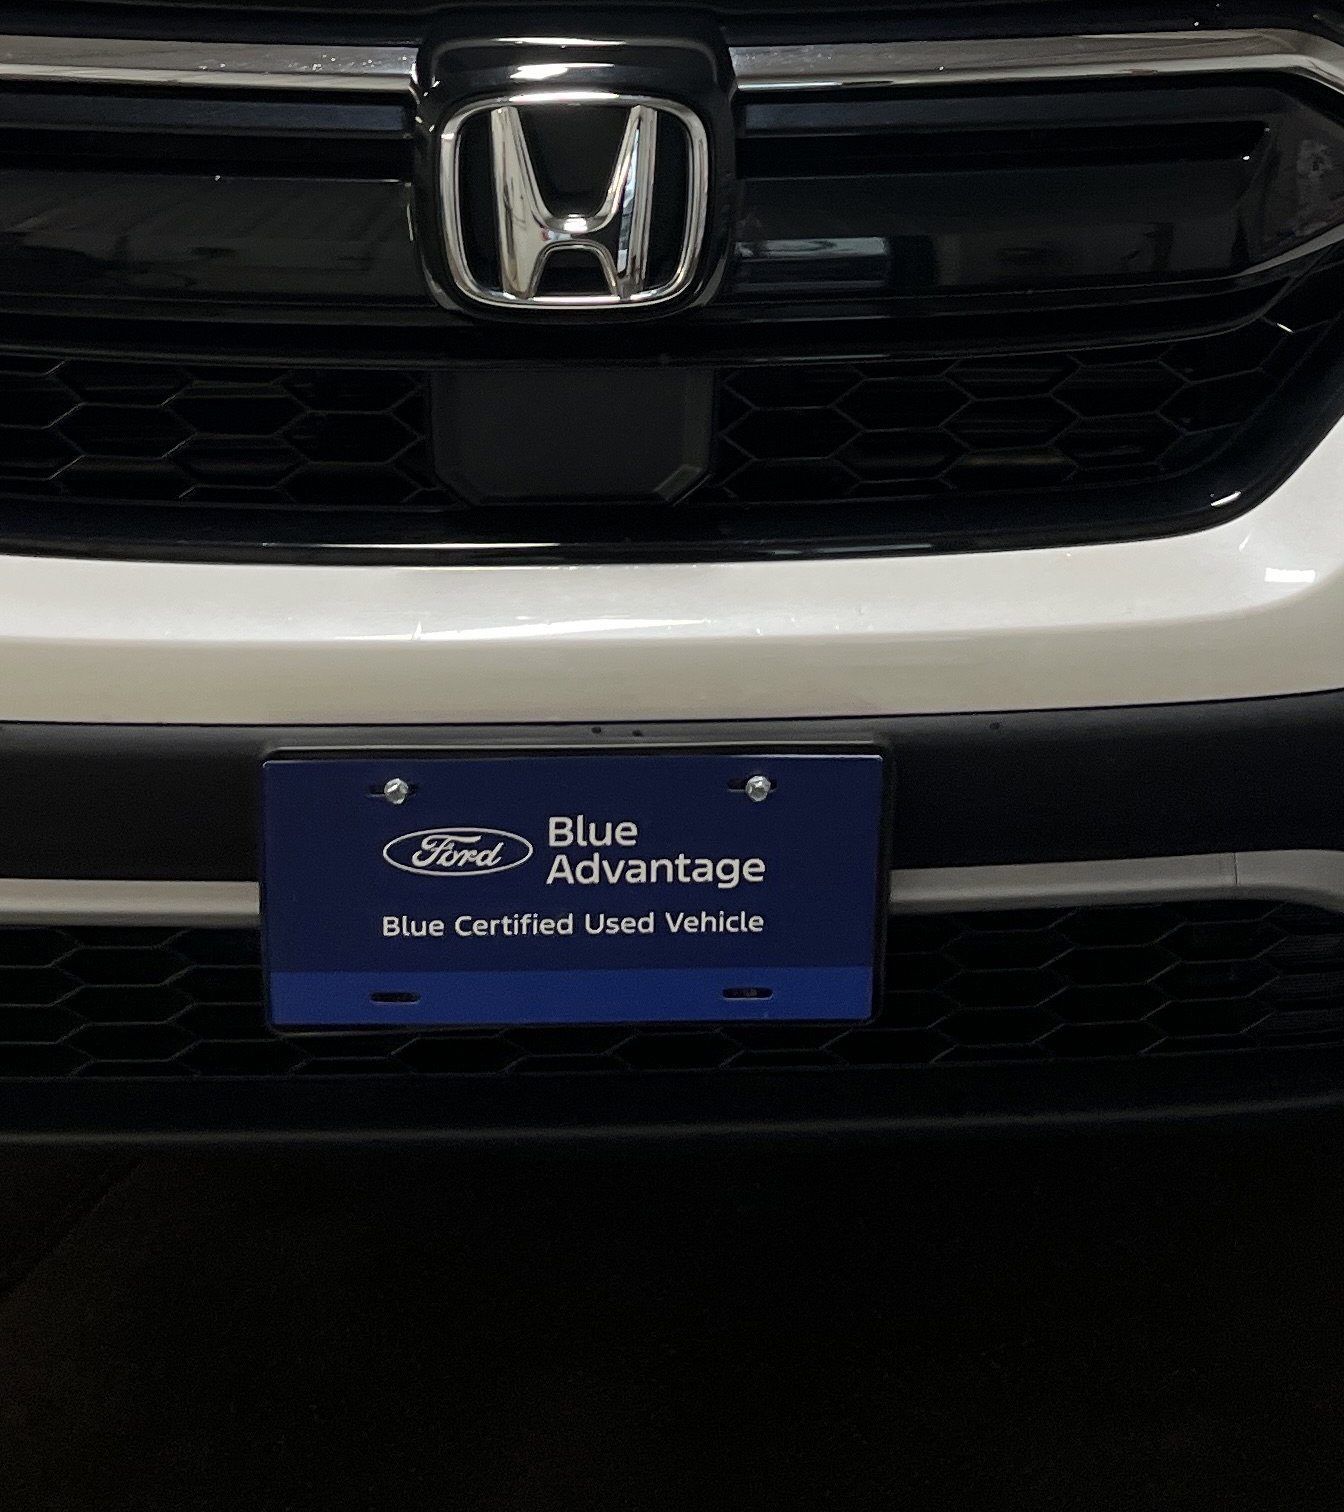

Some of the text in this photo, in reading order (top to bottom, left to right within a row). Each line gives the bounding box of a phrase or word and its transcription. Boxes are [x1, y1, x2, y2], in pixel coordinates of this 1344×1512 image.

[548, 814, 639, 847] Blue
[546, 852, 767, 889] Advantage
[382, 910, 765, 937] Blue Certified Used Vehicle
